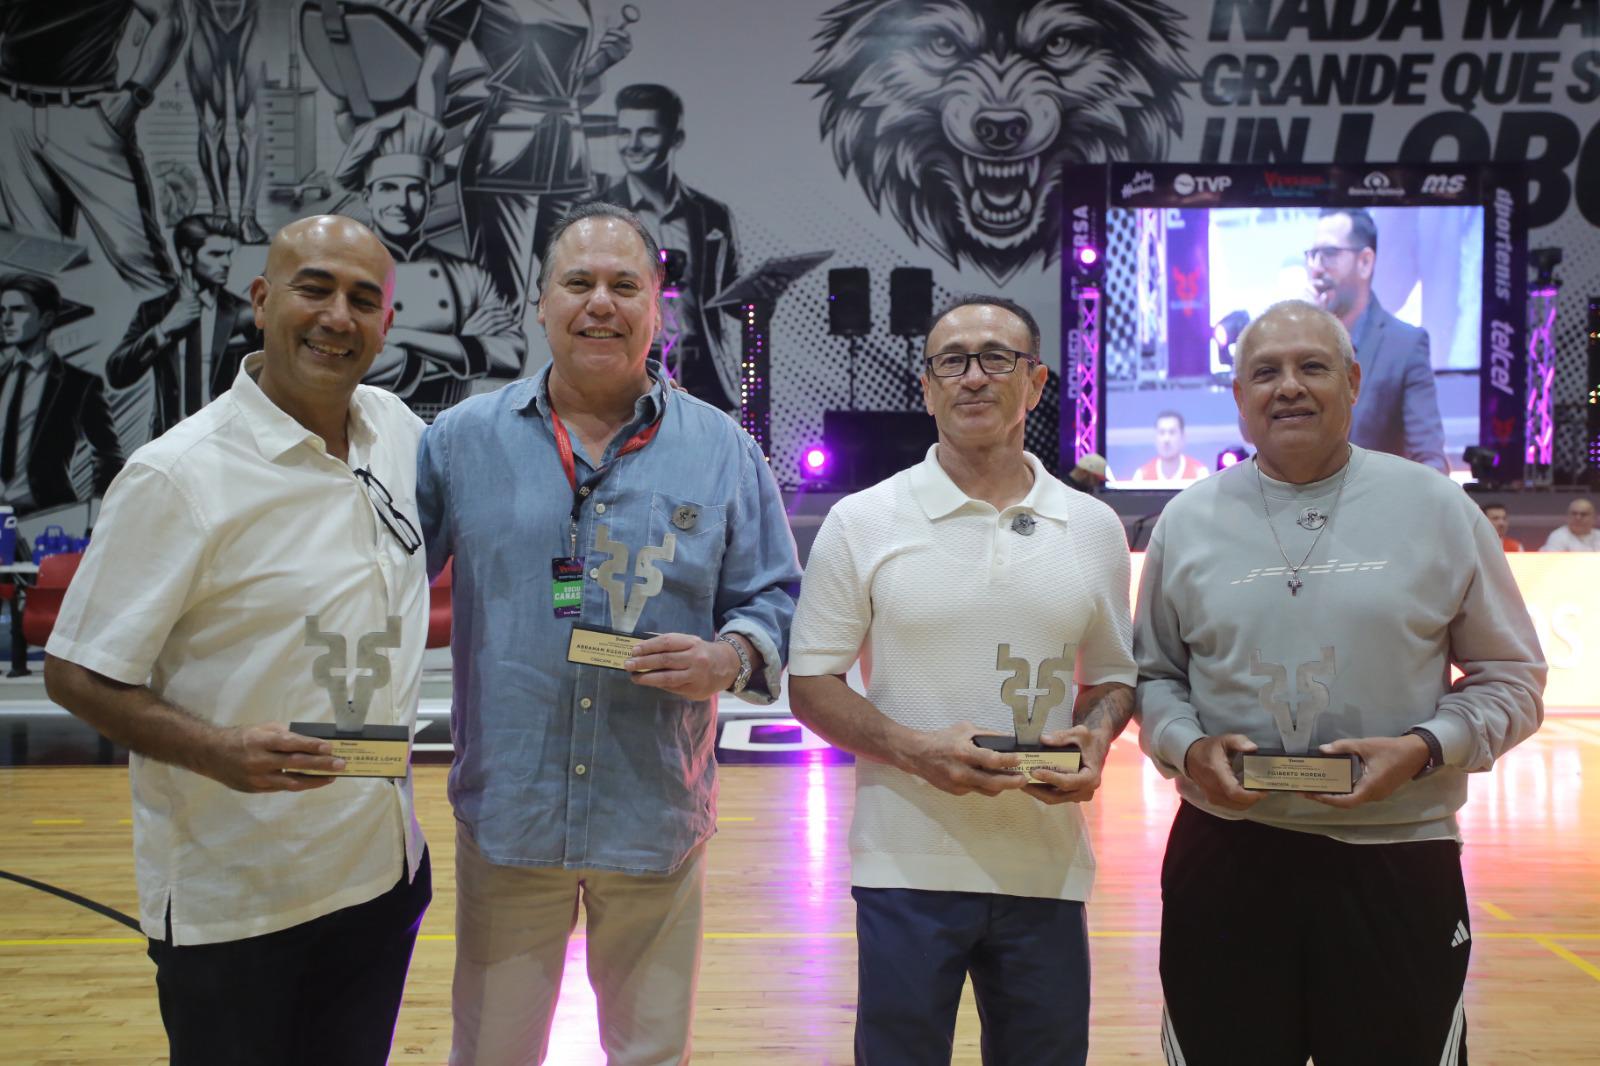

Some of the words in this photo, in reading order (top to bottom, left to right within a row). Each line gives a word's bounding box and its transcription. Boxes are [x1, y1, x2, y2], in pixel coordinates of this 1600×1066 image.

[1208, 0, 1444, 42] NADA
[1201, 53, 1435, 107] GRANDE
[1441, 51, 1561, 113] QUE
[1194, 176, 1232, 193] TVP
[1490, 319, 1515, 395] telcel
